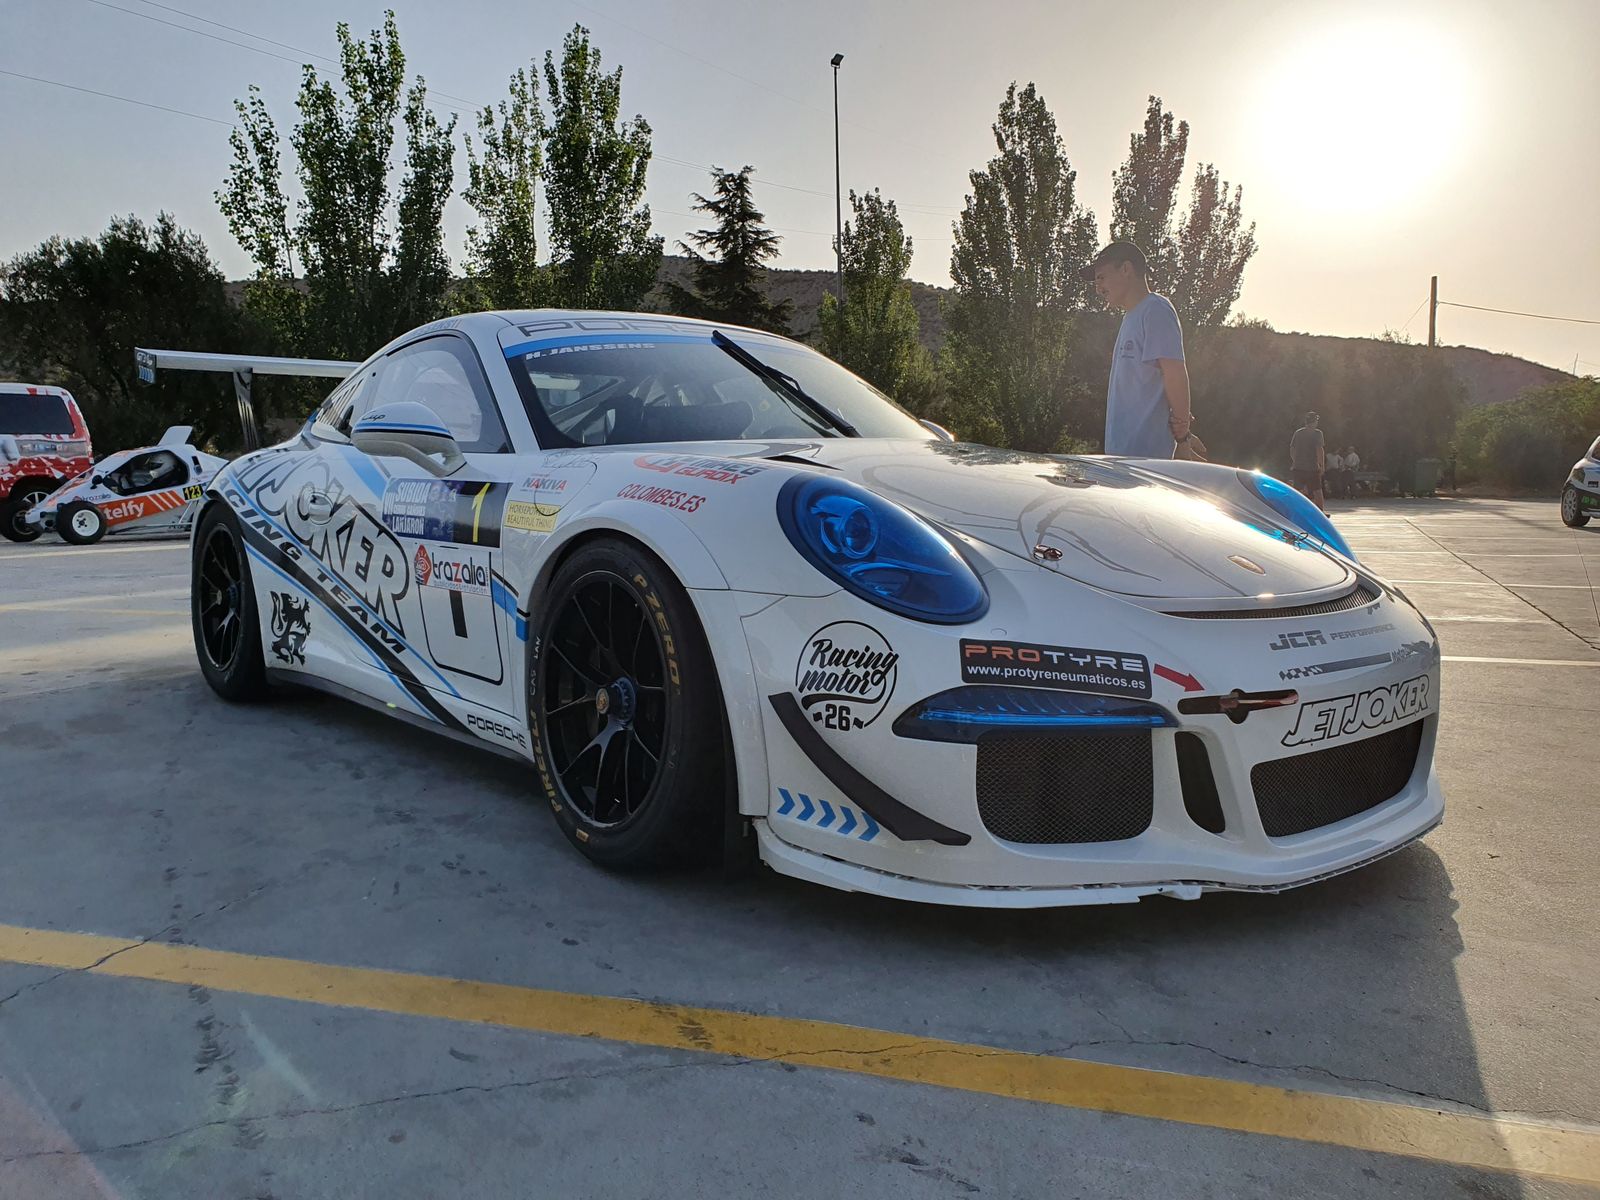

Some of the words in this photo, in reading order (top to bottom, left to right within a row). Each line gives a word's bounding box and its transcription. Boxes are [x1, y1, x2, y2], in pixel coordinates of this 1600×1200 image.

[184, 485, 200, 499] 123
[523, 477, 567, 491] NAKIVA
[616, 483, 706, 513] COLOMBES.ES
[105, 501, 144, 521] telfy
[471, 482, 490, 543] 1
[432, 552, 487, 587] trazalia
[317, 568, 407, 654] TEAM
[633, 574, 648, 589] P
[645, 591, 681, 686] ZERO
[810, 638, 899, 680] Racing
[965, 645, 1144, 673] PROTYRE
[968, 665, 1146, 690] www.protyreneumaticos.es
[467, 714, 527, 749] PORSCHE
[825, 703, 850, 731] 26
[530, 709, 562, 812] PIRELLI
